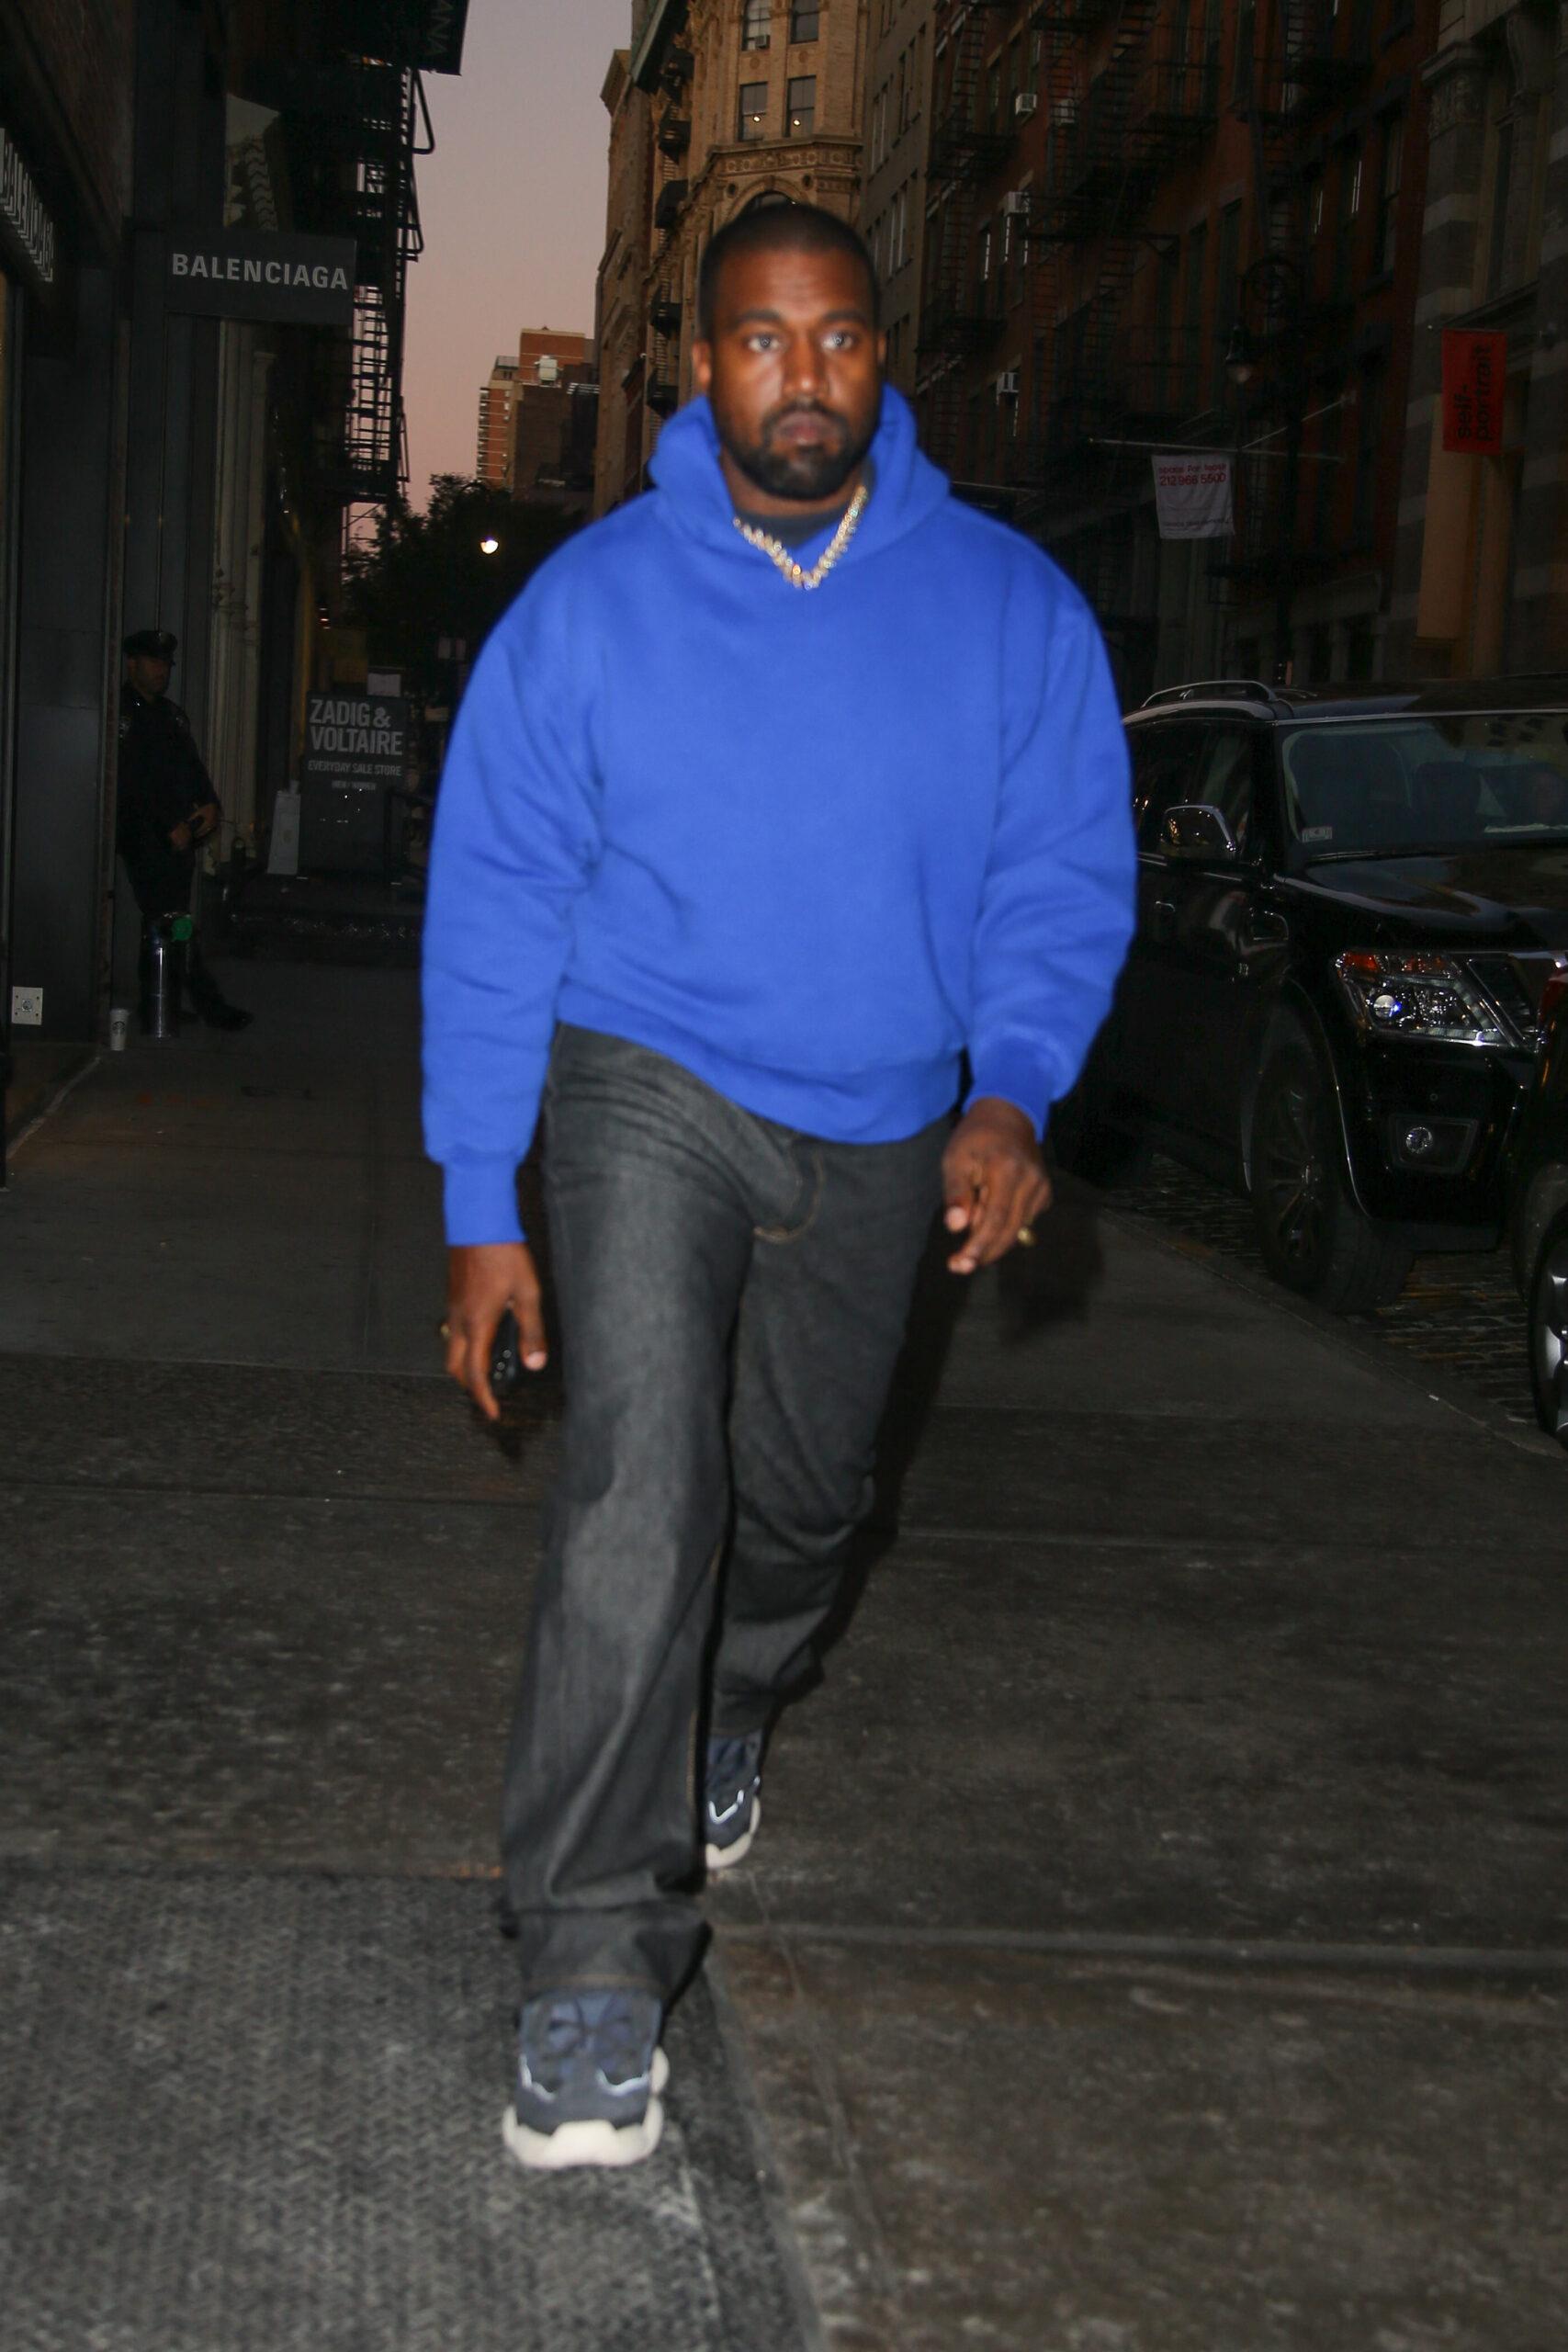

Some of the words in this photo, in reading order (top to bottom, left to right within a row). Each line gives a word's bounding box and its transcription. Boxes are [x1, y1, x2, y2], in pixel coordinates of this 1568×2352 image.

[172, 253, 348, 291] BALENCIAGA
[309, 698, 370, 728] ZADIG
[372, 707, 391, 729] &
[310, 726, 403, 756] VOLTAIRE
[308, 760, 350, 773] EVERYDAY
[352, 763, 373, 775] SALE
[374, 764, 402, 777] STORE
